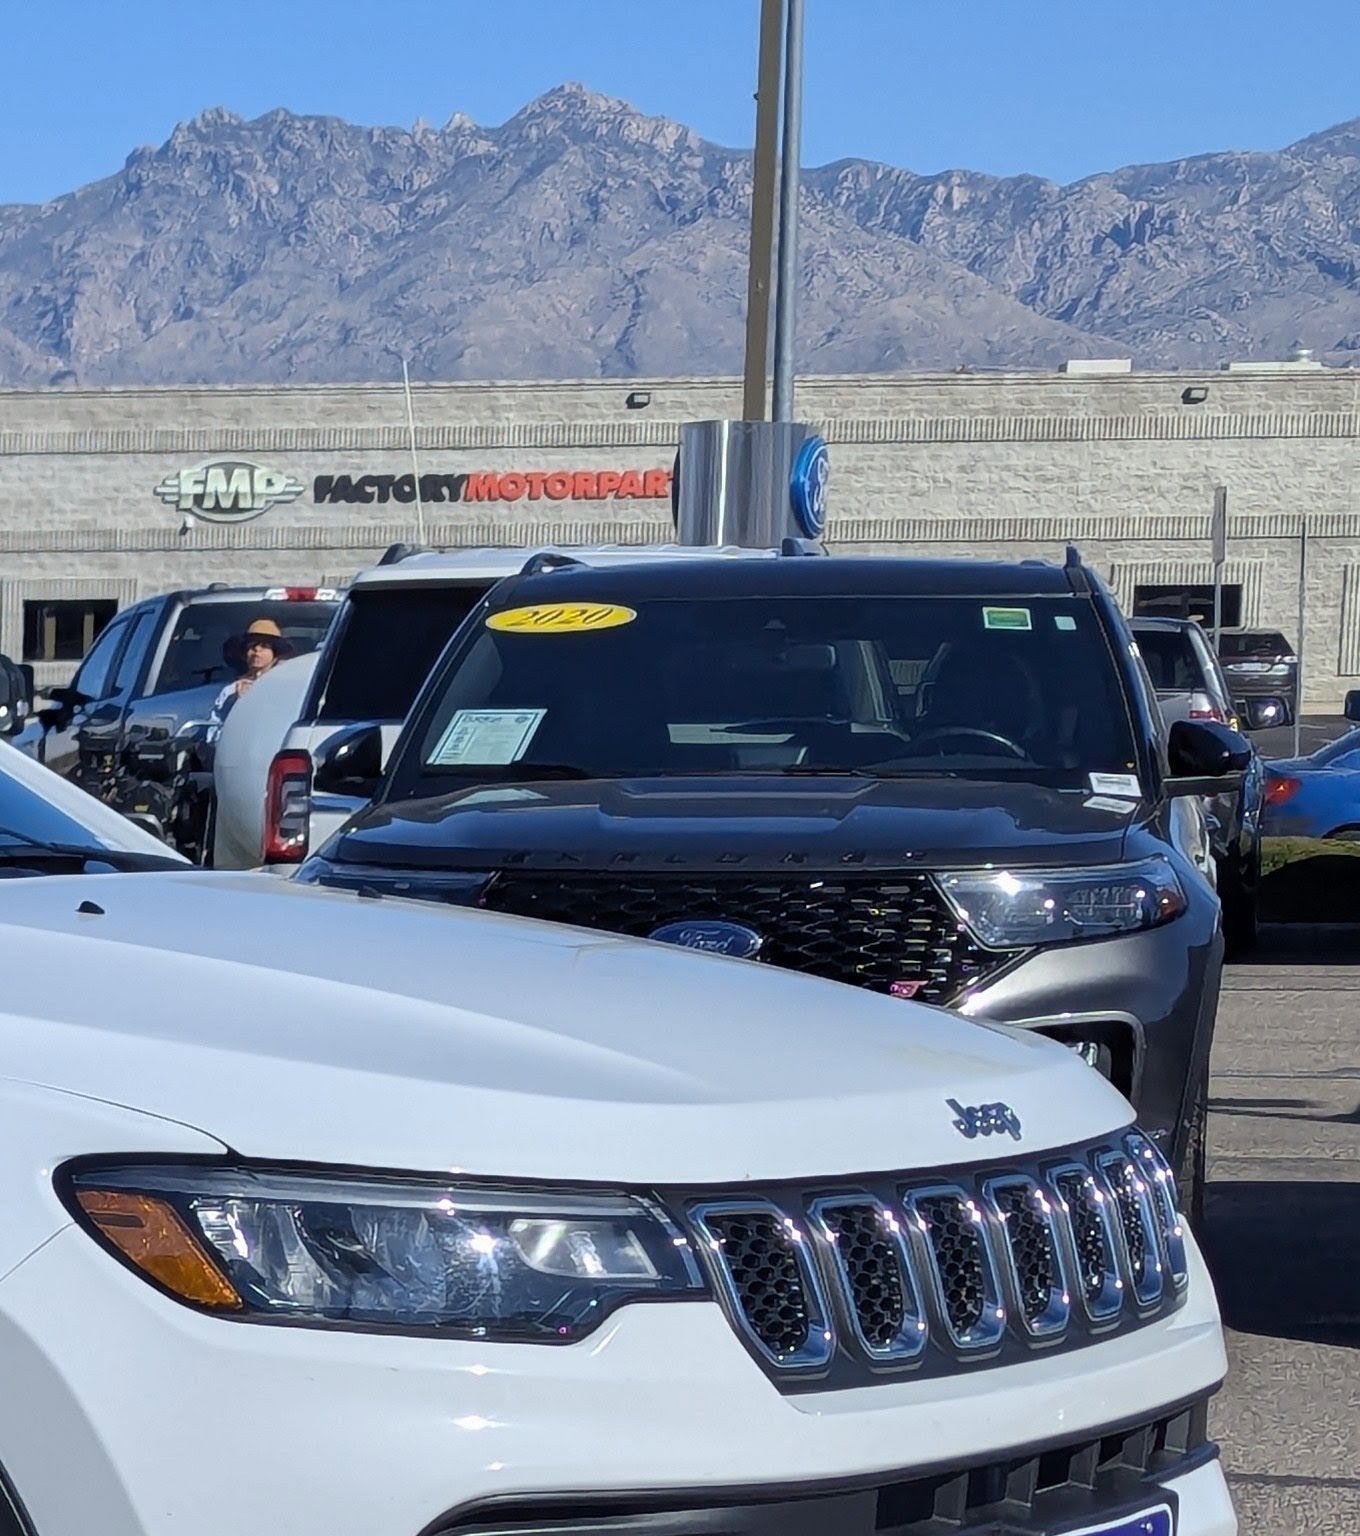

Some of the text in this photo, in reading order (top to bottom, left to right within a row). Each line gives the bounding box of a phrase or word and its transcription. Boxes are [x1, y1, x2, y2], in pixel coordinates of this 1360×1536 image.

[177, 467, 288, 511] FMP
[505, 607, 614, 627] 2020
[945, 1098, 1022, 1141] Jeep
